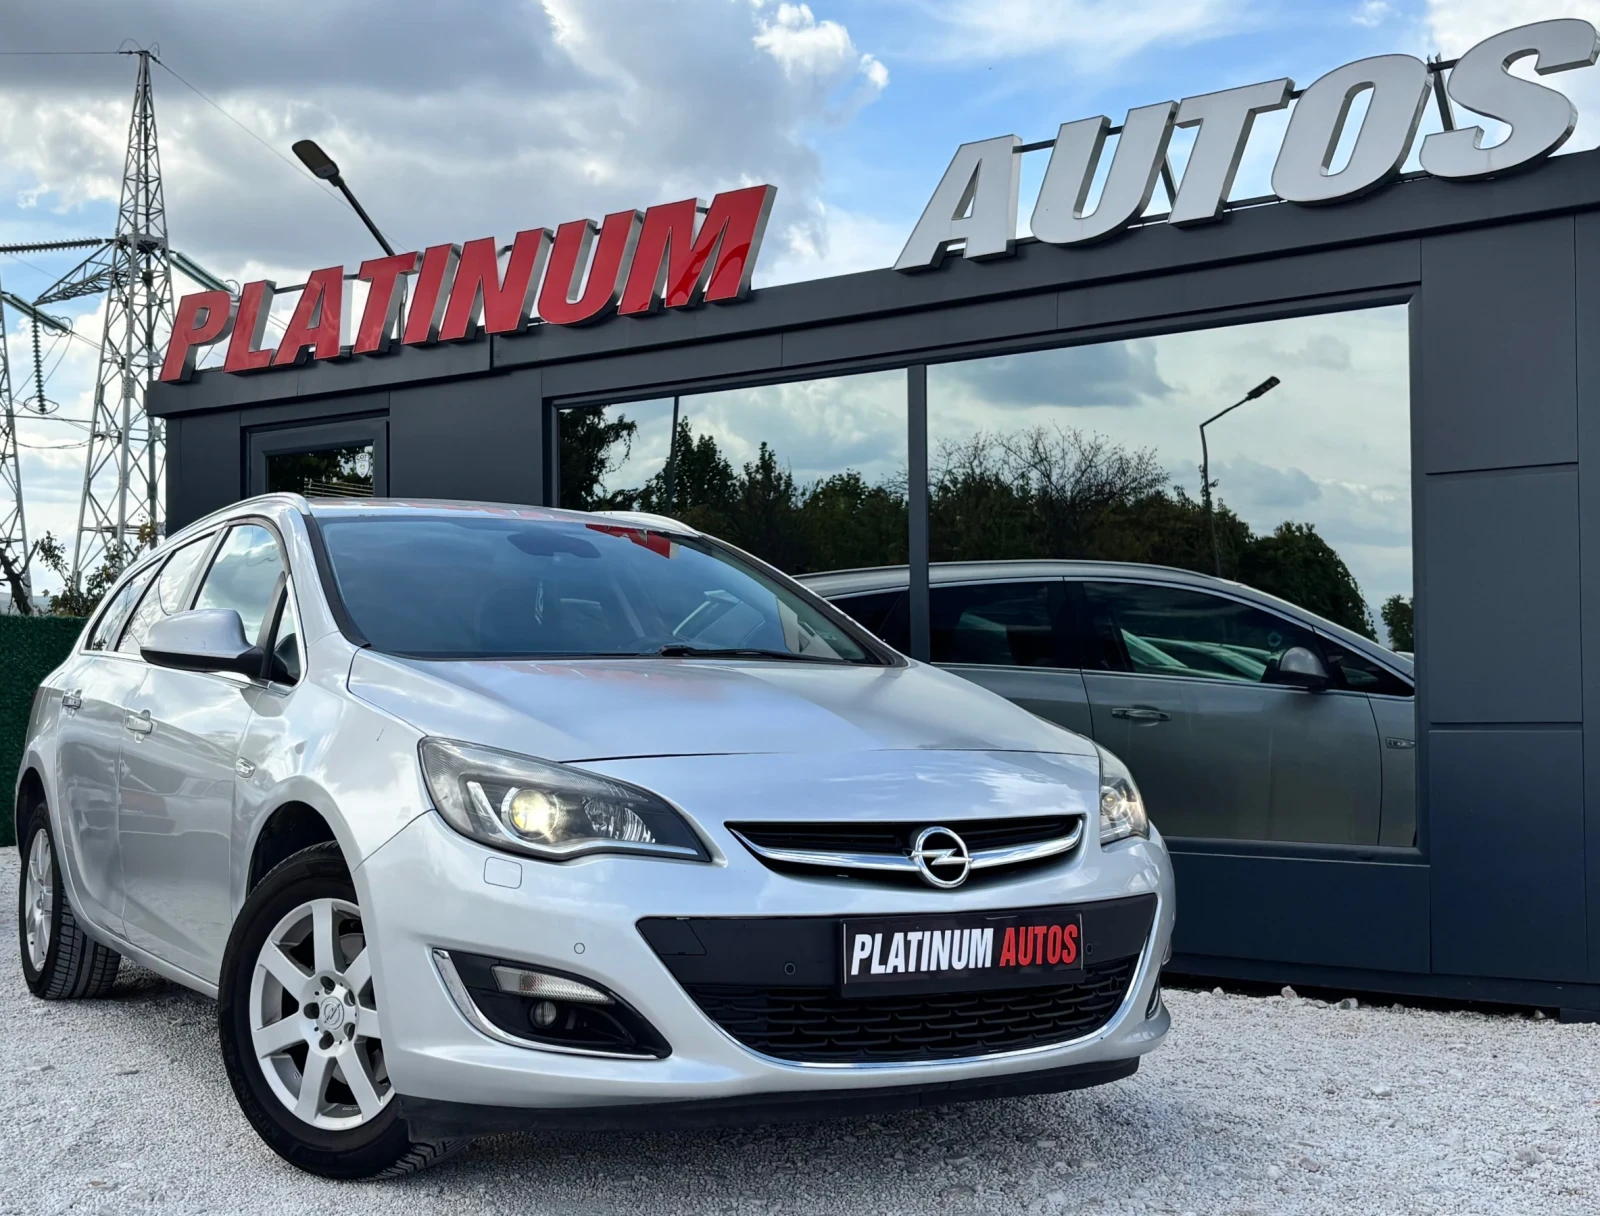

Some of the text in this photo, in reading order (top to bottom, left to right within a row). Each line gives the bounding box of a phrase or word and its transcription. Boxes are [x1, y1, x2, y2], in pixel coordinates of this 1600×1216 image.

[160, 17, 1600, 383] PLATINUM AUTOS
[850, 924, 1079, 976] PLATINUM AUTOS
